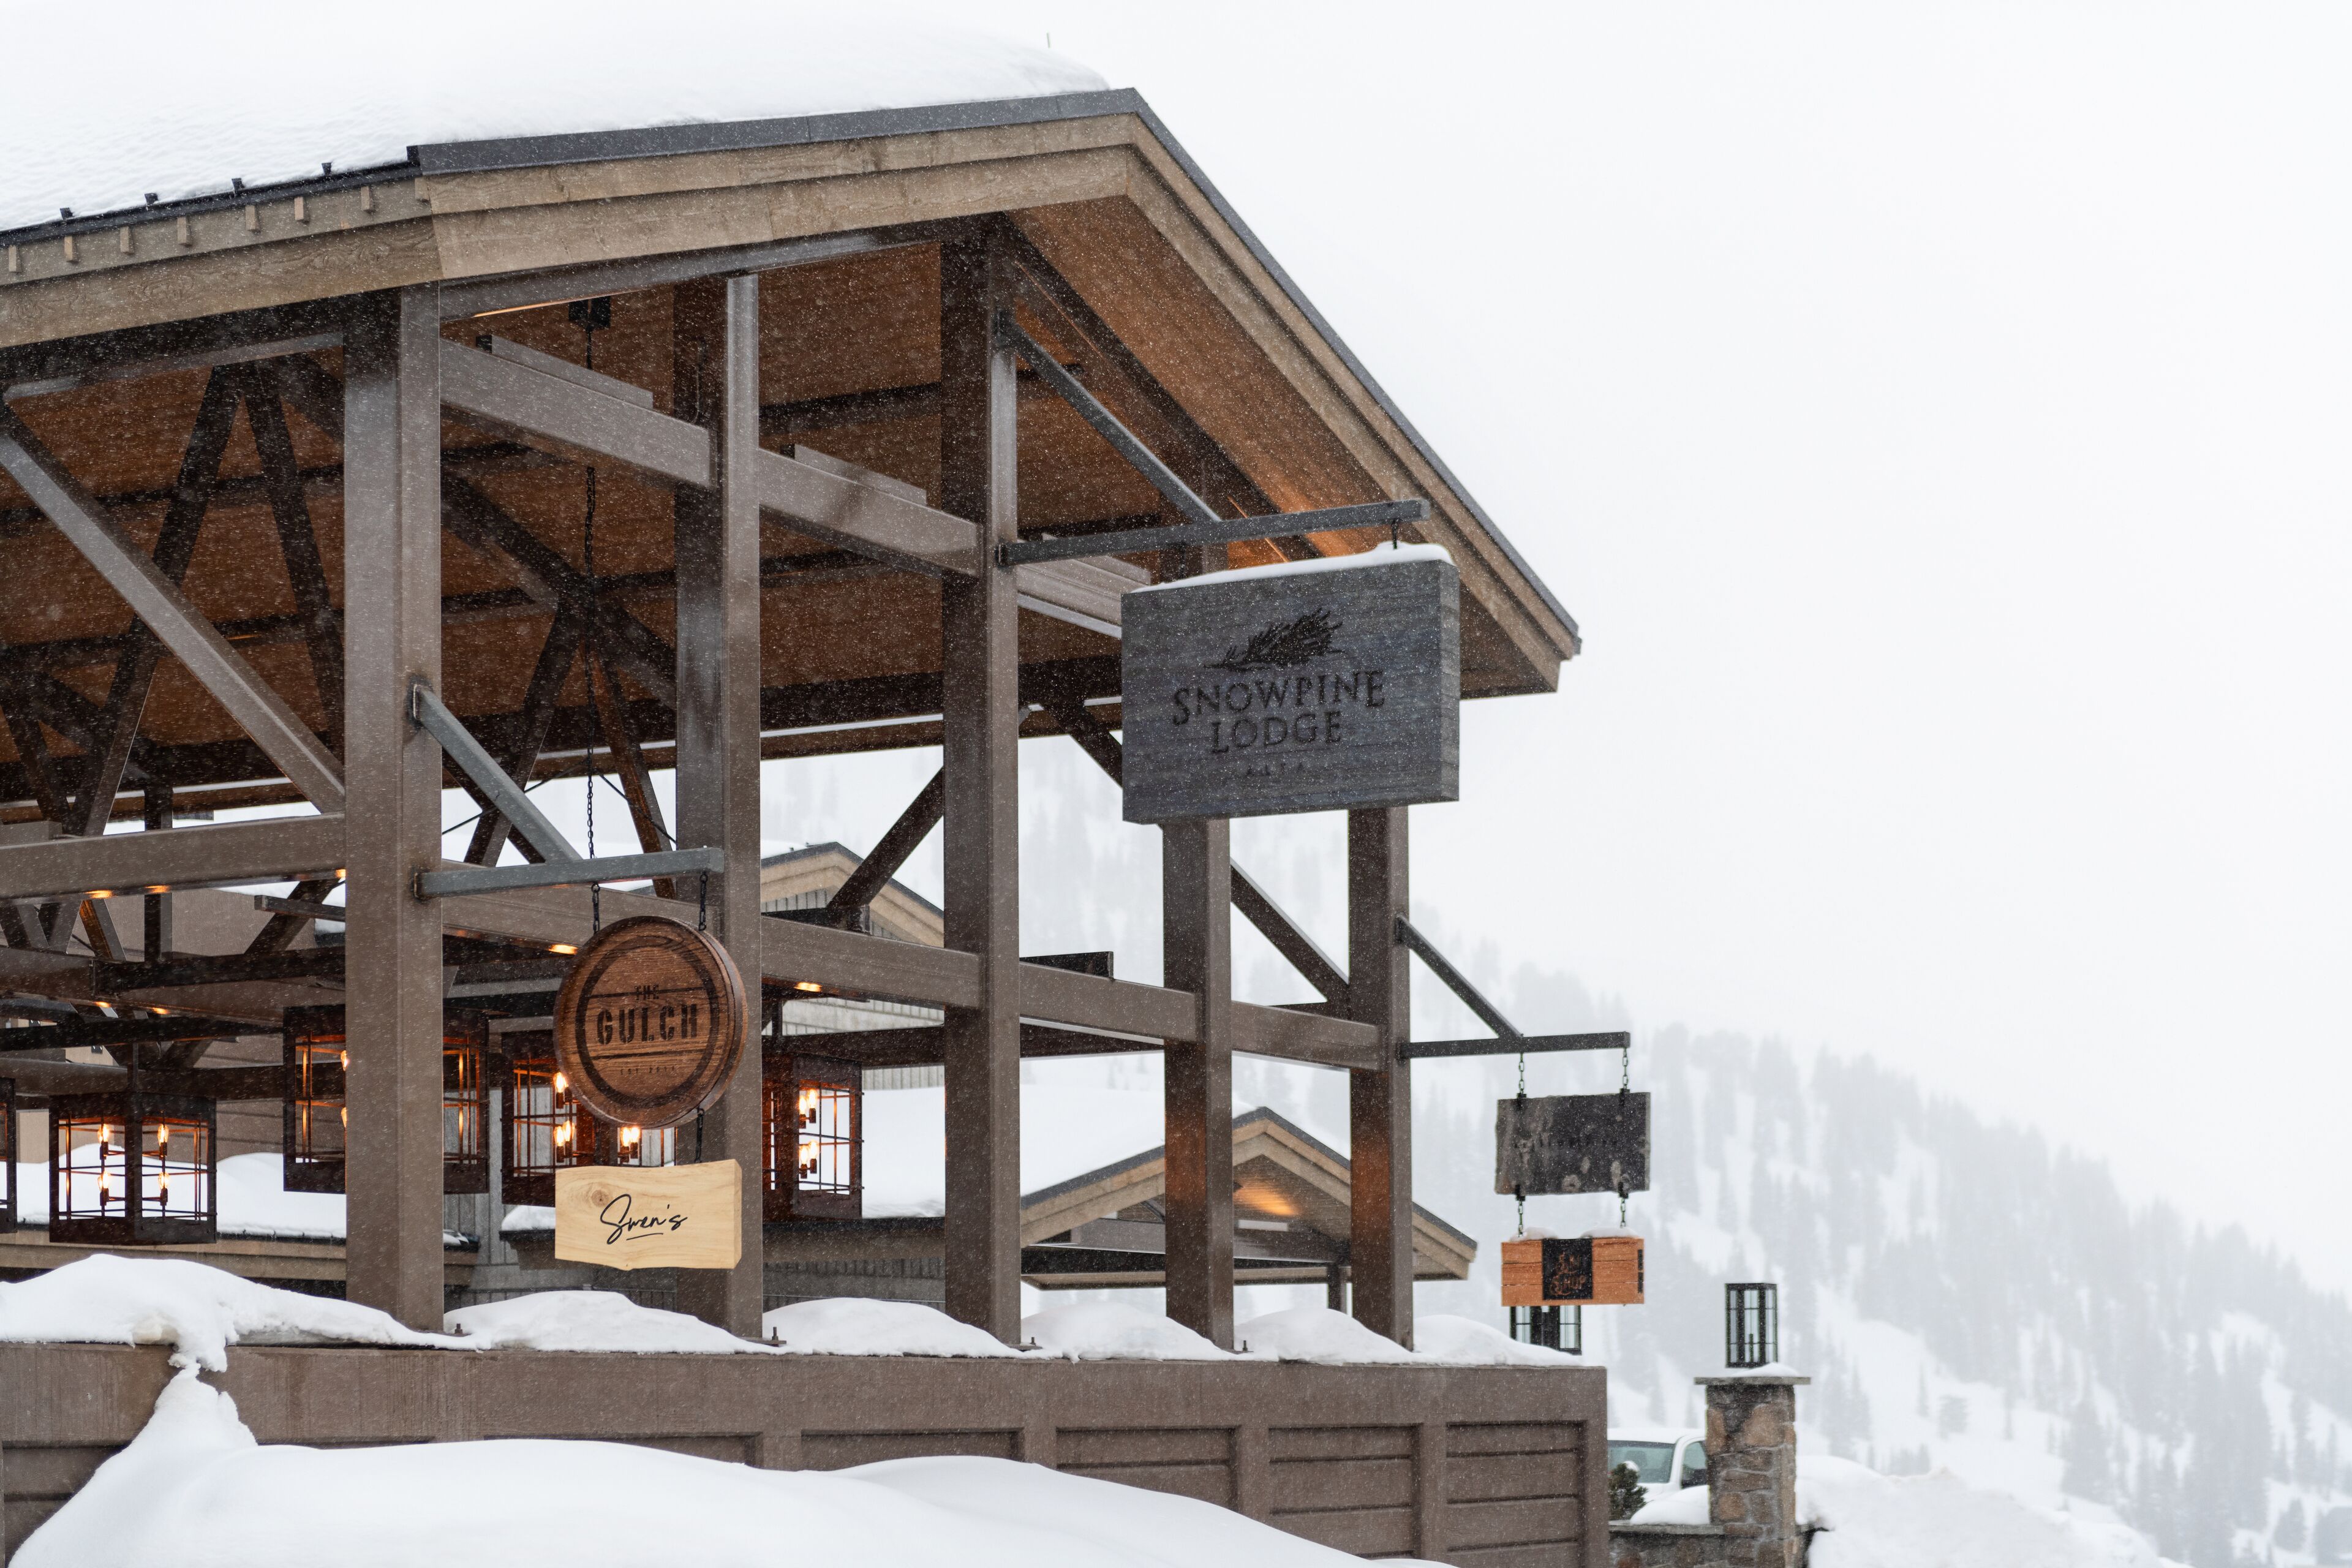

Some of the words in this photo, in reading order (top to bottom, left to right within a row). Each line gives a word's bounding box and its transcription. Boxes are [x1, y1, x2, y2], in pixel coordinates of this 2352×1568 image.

[1172, 669, 1385, 726] SNOWPINE
[1211, 710, 1342, 754] LODGE
[634, 984, 660, 1001] THE
[597, 1003, 698, 1045] GULCH
